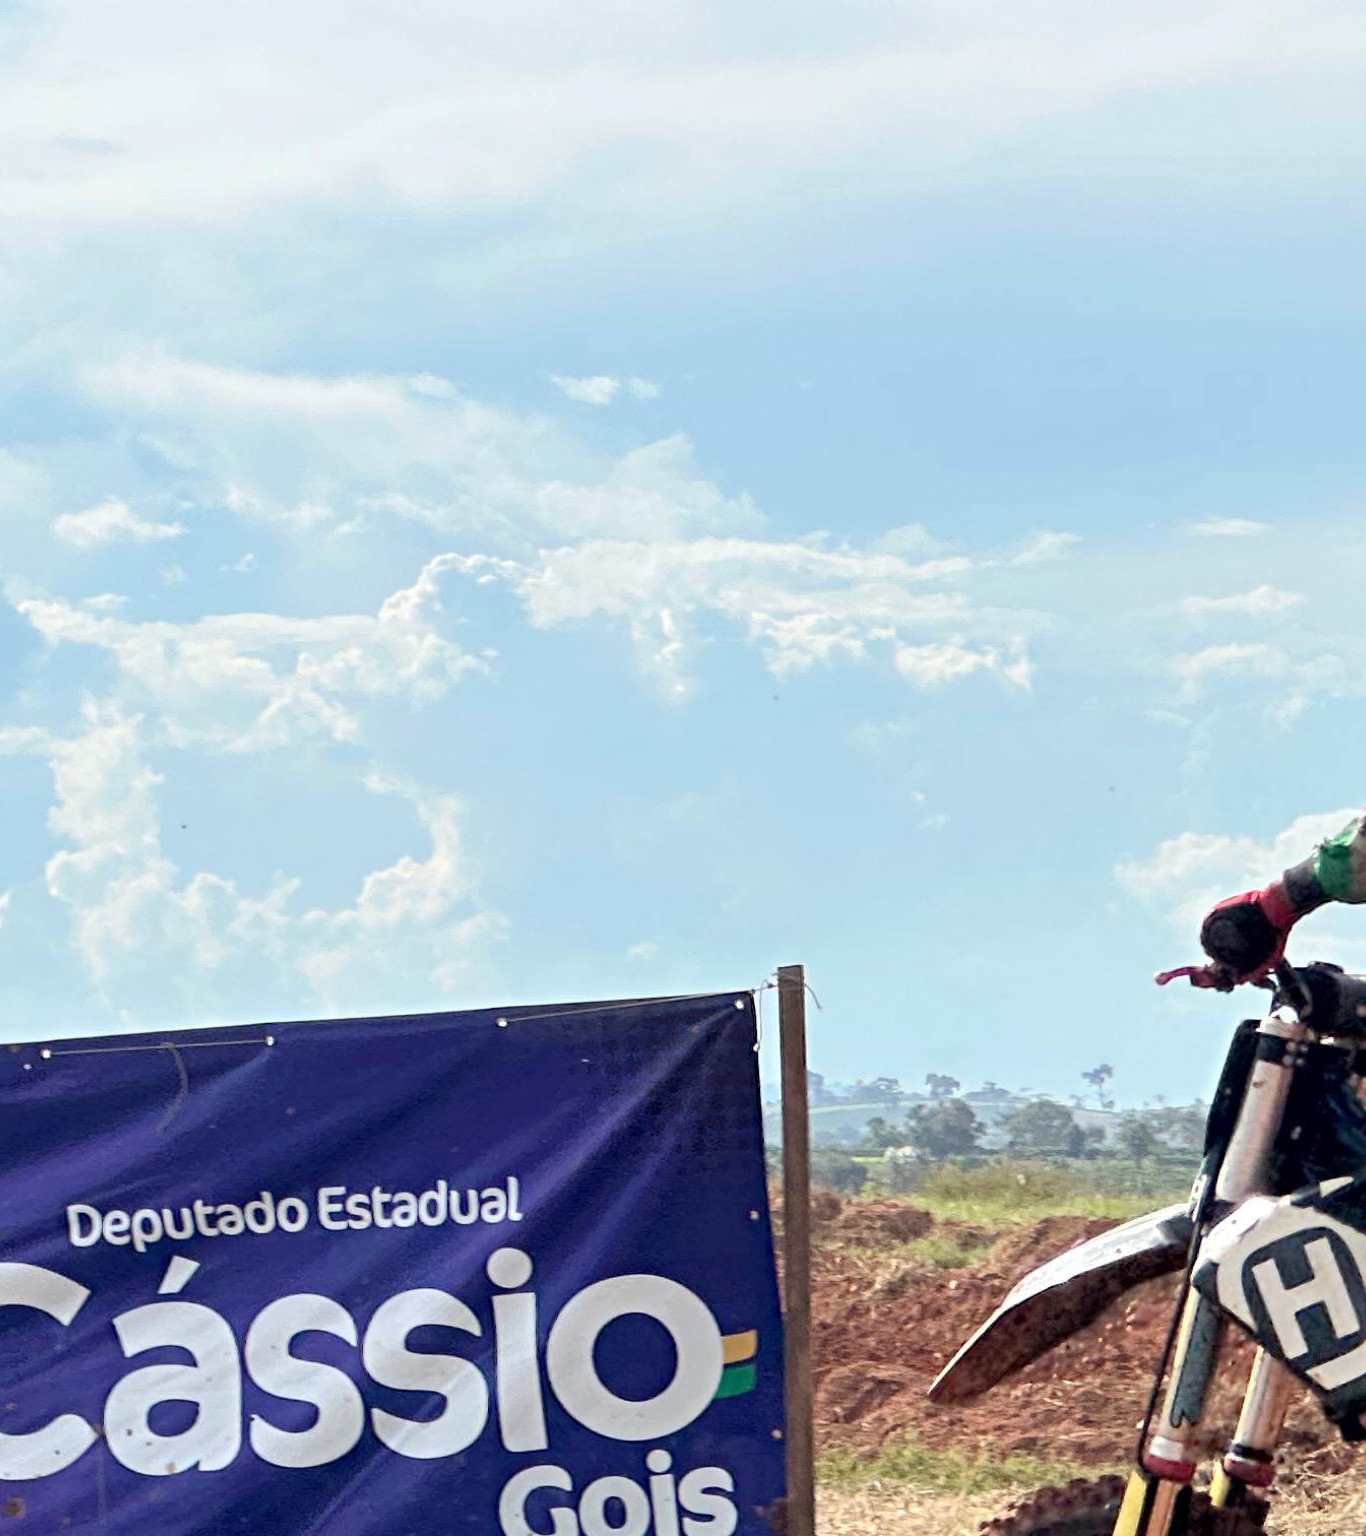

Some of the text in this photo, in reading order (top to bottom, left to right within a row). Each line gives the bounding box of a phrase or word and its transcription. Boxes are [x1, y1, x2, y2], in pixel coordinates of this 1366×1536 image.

[67, 1176, 524, 1252] Deputado Estadual
[1252, 1237, 1361, 1359] H
